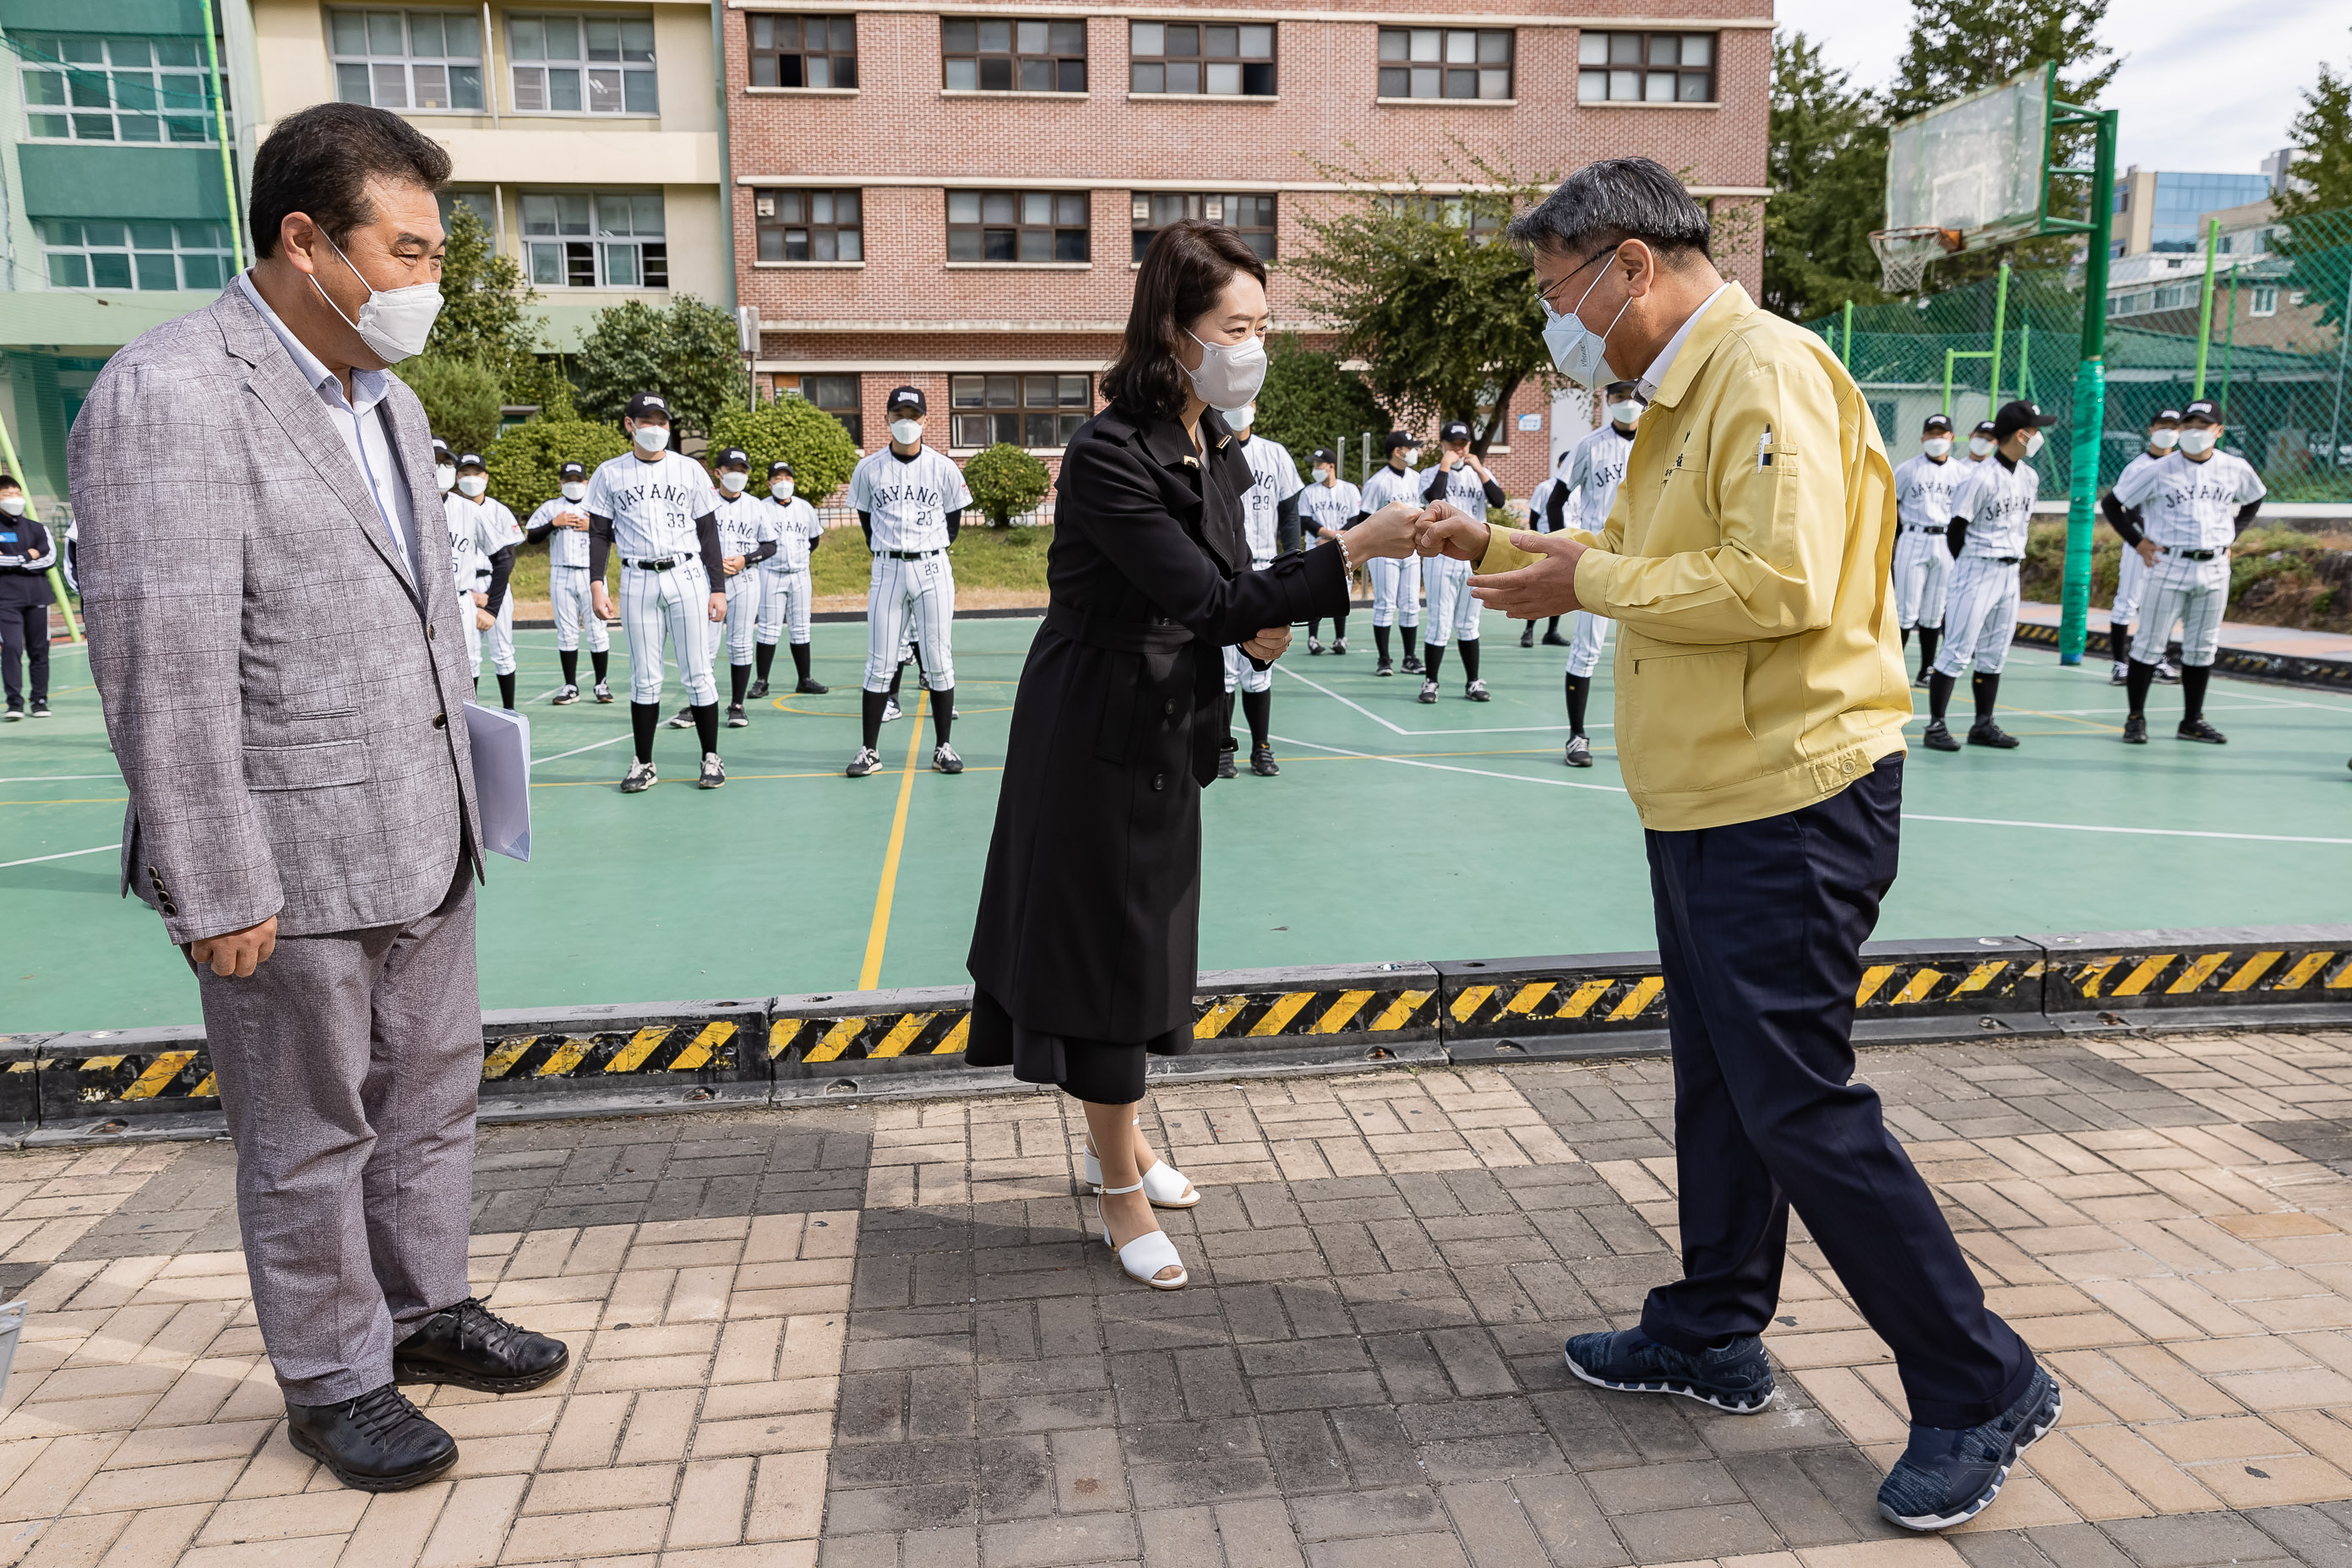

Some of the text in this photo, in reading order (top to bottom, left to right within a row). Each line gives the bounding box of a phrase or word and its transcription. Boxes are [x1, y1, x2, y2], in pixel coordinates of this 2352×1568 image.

[1595, 463, 1623, 487] JAY
[1252, 495, 1270, 510] 29
[667, 512, 685, 528] 33
[917, 511, 933, 526] 23
[716, 520, 753, 539] YANG
[737, 541, 750, 554] 36
[683, 567, 701, 581] 33
[924, 563, 939, 576] 23
